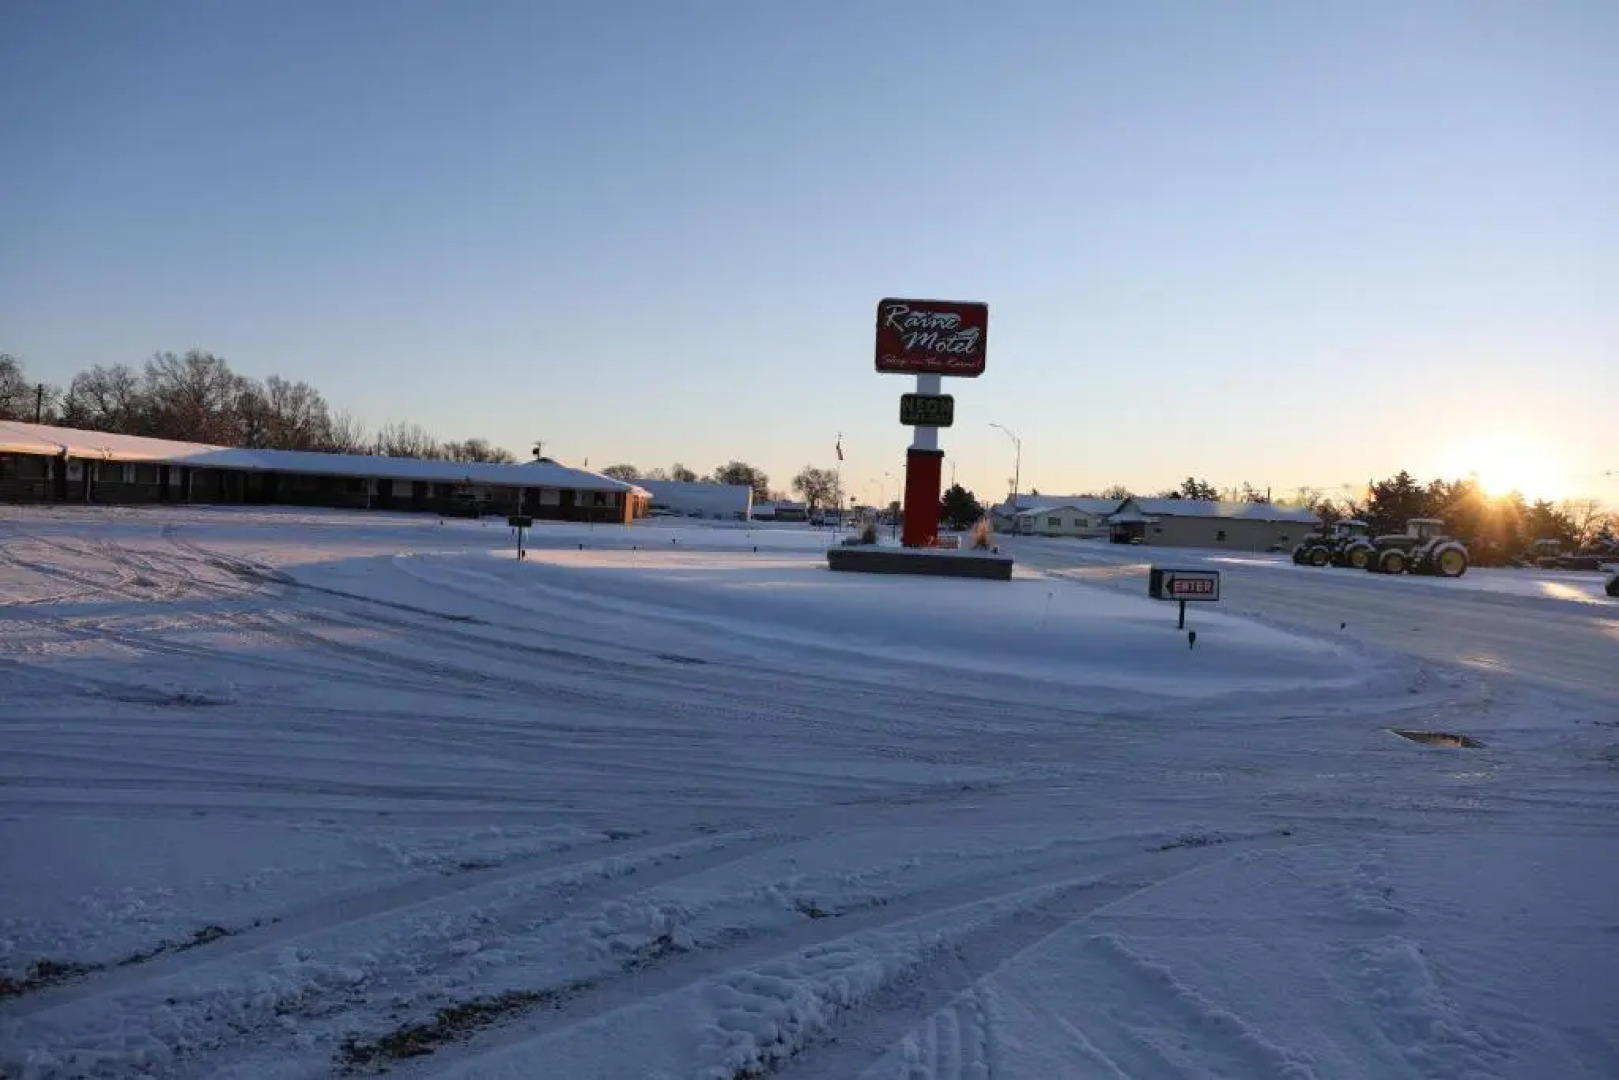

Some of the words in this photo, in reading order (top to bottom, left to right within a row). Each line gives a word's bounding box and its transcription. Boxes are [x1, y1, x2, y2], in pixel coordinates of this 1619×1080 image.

[886, 304, 957, 332] Raine
[903, 327, 979, 353] Motel
[1174, 581, 1213, 593] ENTER
